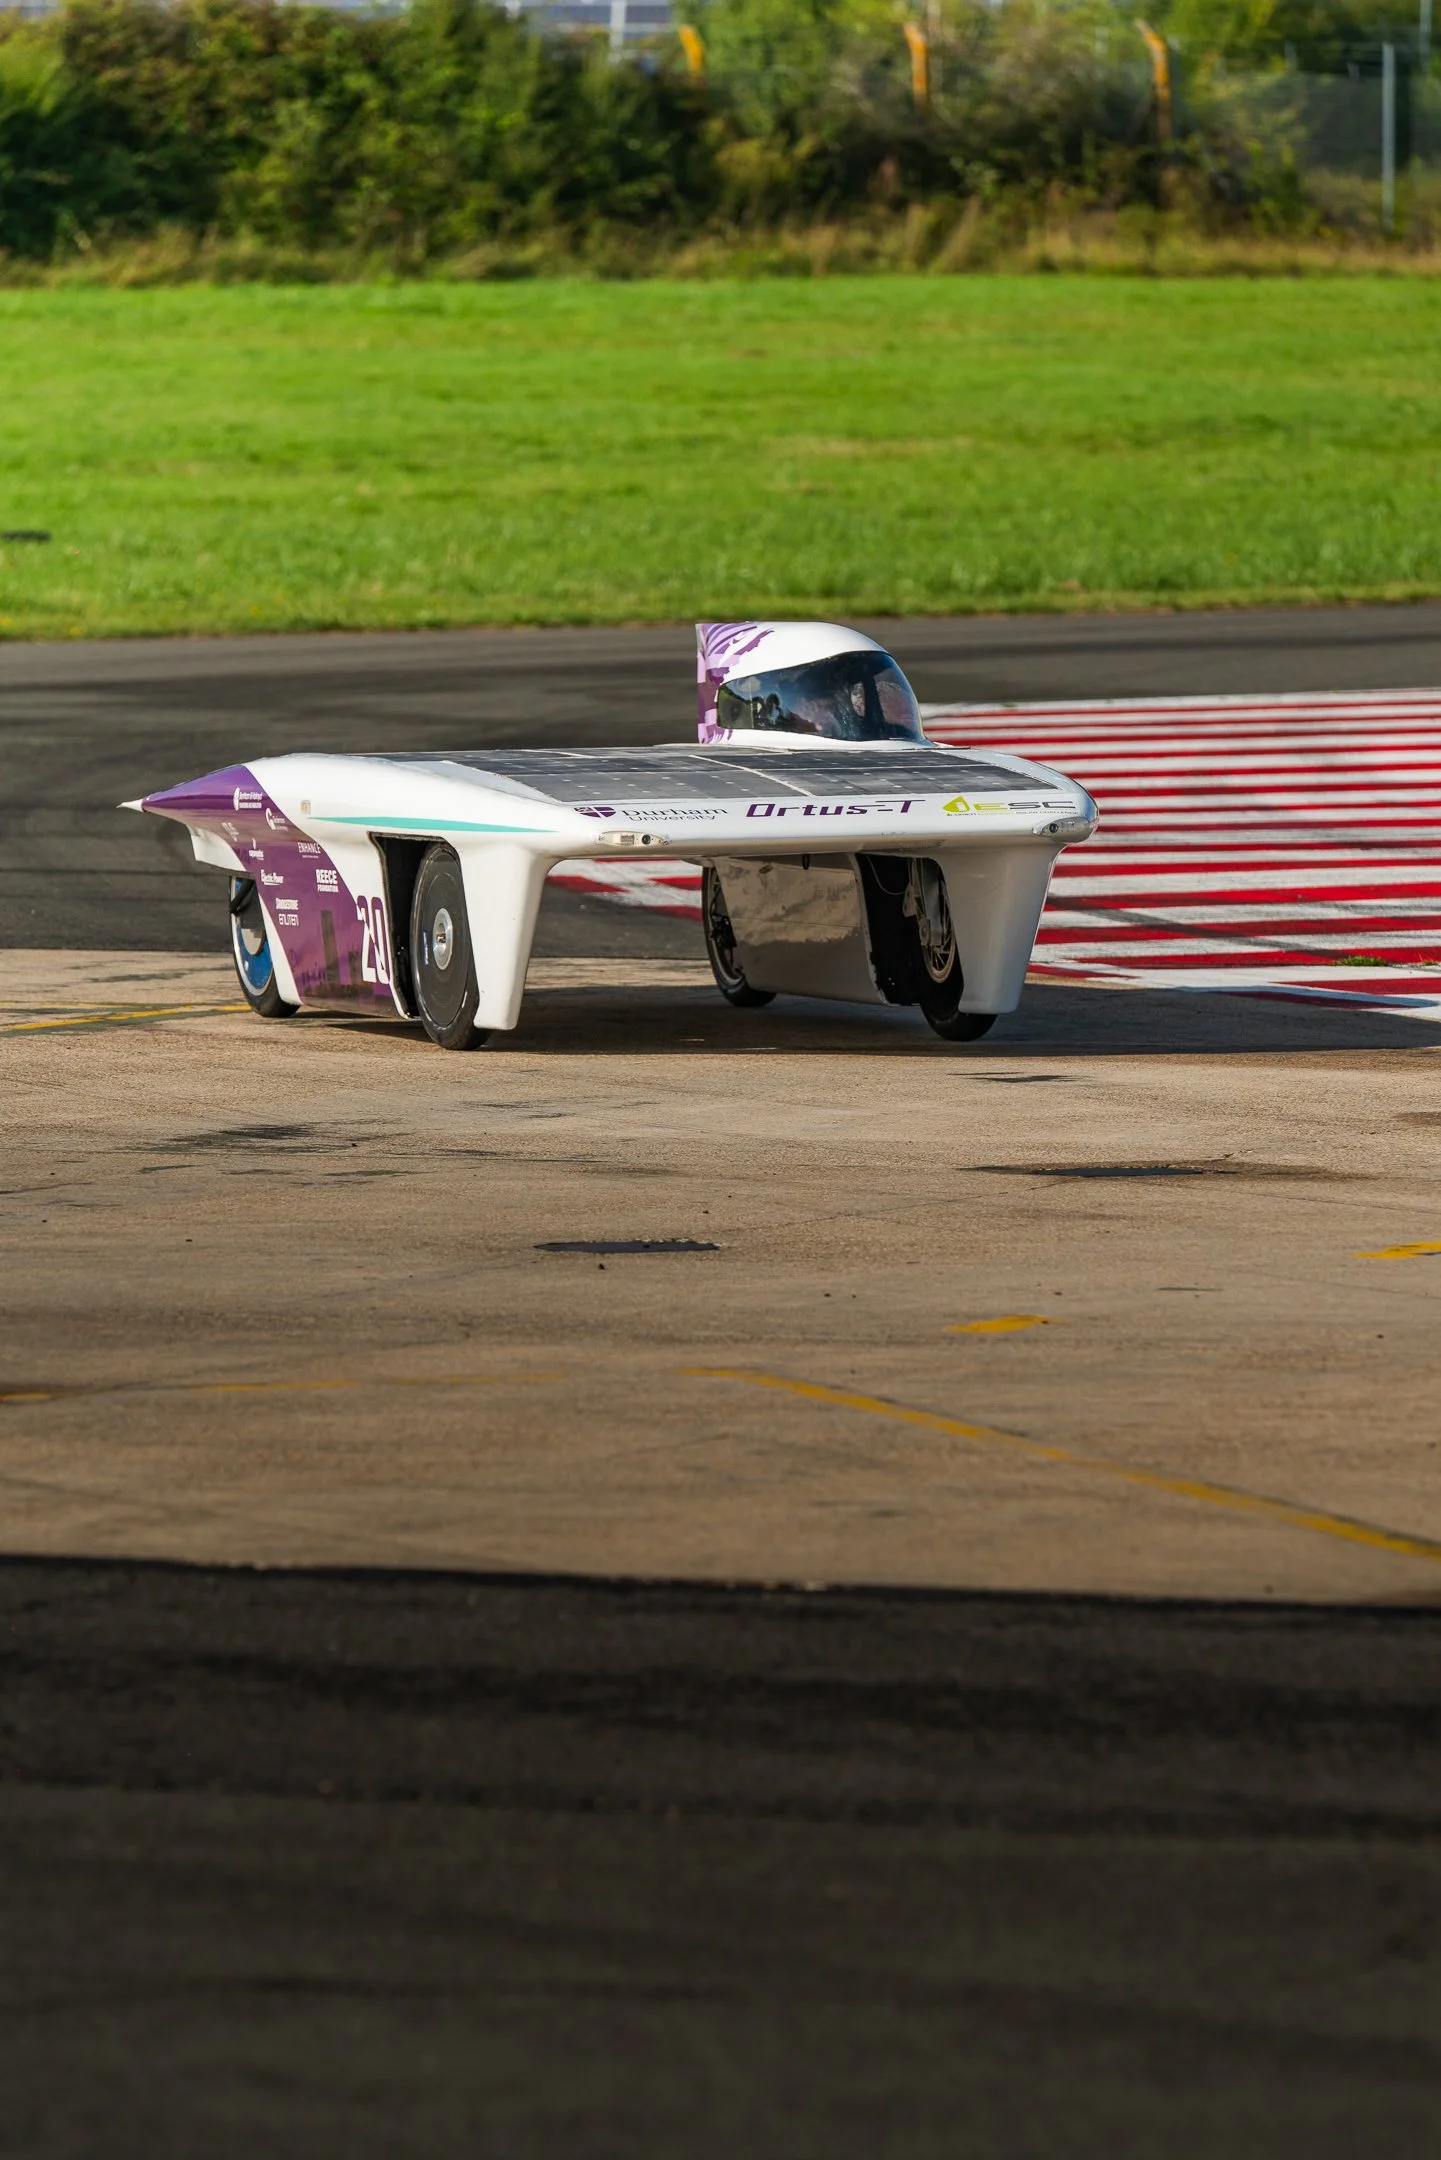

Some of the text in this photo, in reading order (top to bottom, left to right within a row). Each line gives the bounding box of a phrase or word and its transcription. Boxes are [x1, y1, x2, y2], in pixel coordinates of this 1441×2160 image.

[621, 808, 728, 816] Durham
[745, 799, 926, 817] Ortus-T
[297, 842, 322, 854] ENHANCE
[316, 869, 338, 884] REECE
[357, 895, 390, 984] 20
